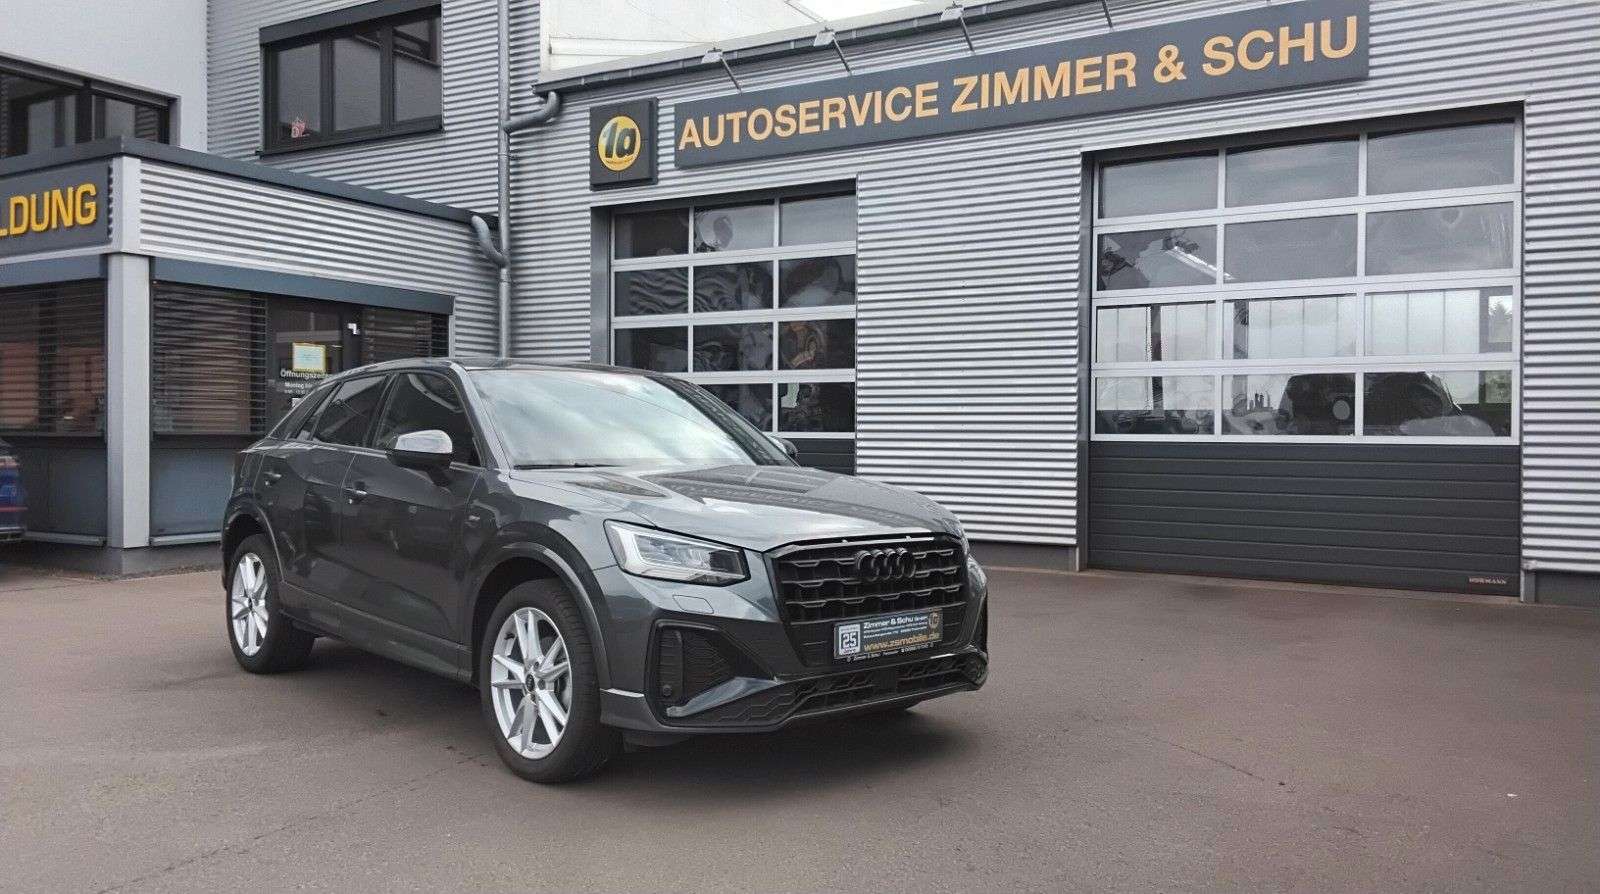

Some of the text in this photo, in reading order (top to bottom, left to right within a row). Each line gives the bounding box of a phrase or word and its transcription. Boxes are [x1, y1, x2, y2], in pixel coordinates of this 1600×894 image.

[678, 15, 1358, 151] AUTOSERVICE ZIMMER & SCHU
[842, 631, 857, 649] 25
